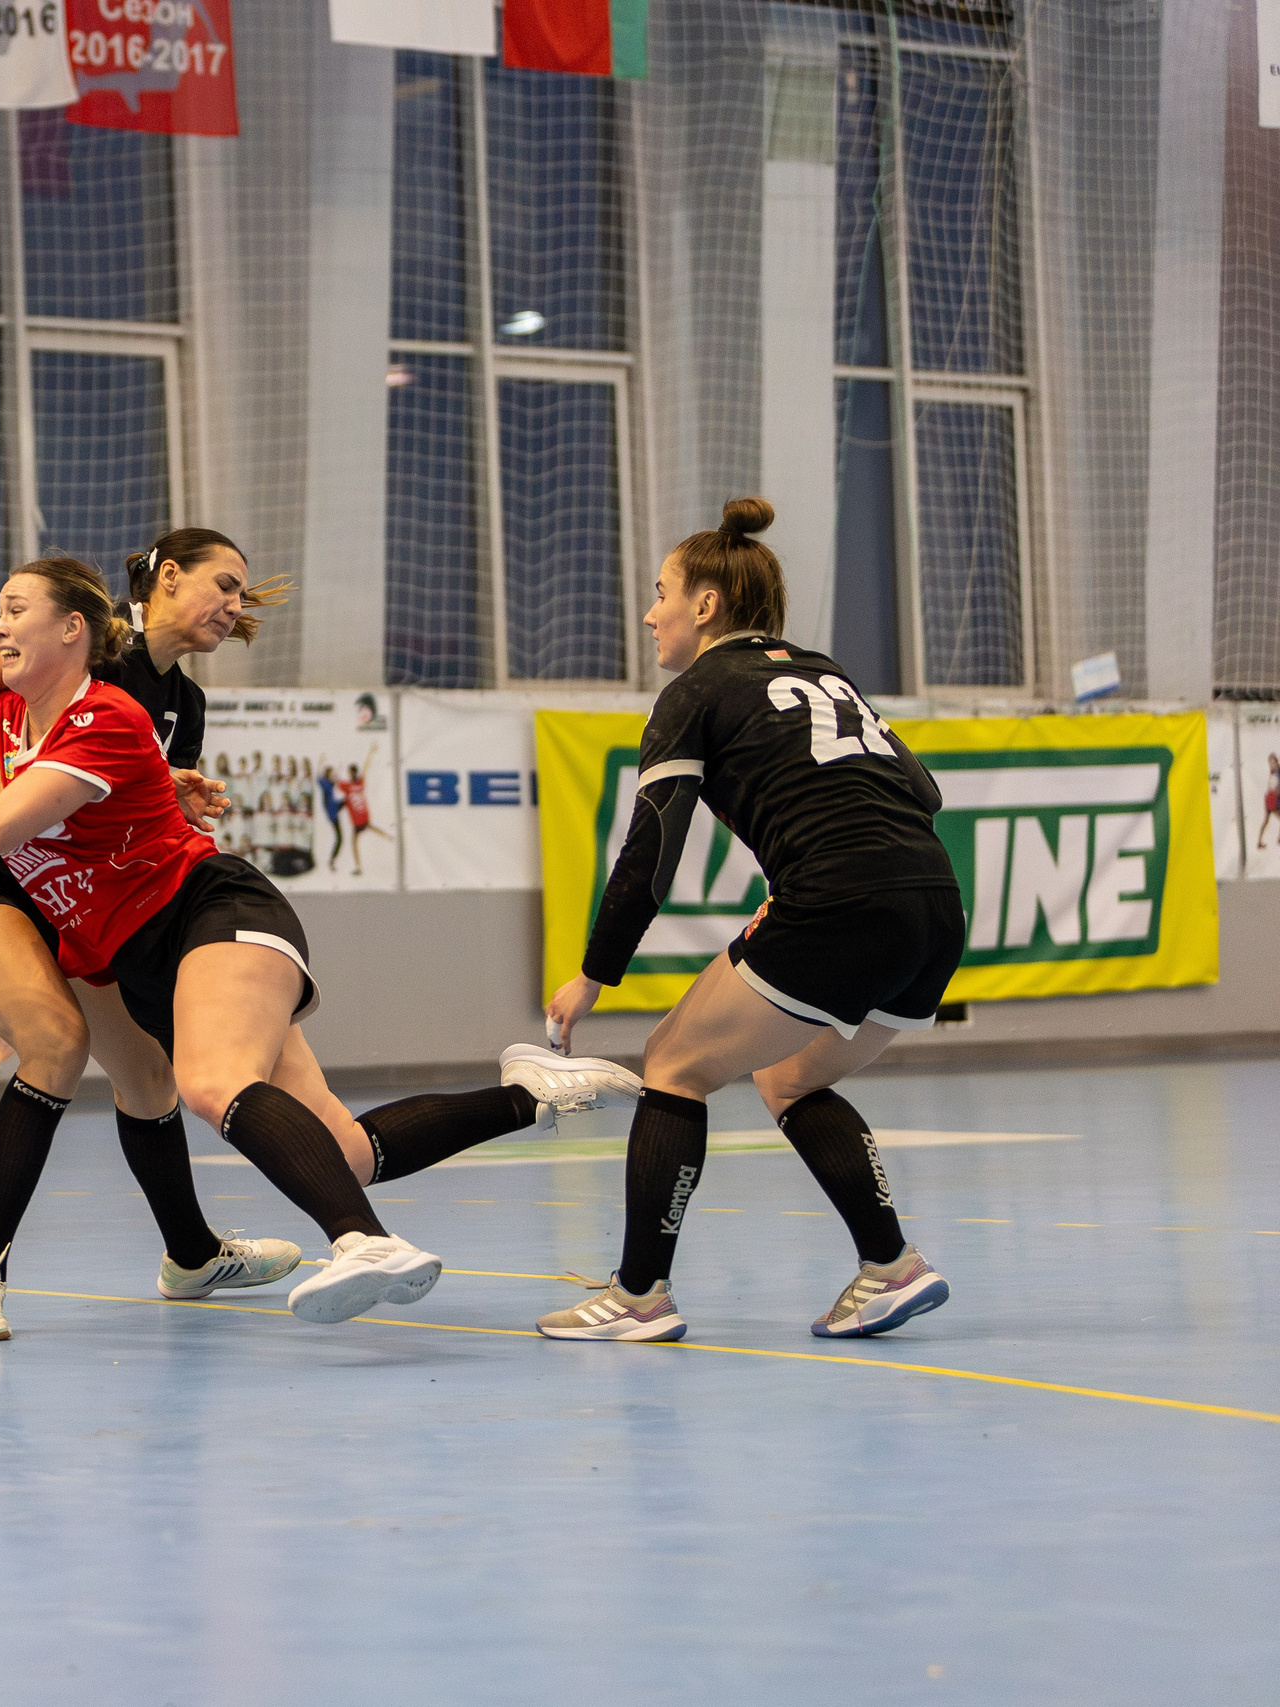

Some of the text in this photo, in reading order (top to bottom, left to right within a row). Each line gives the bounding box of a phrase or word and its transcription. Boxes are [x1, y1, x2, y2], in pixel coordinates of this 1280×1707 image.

[70, 31, 228, 76] 2016-2017
[163, 711, 178, 753] 7
[767, 674, 898, 765] 22
[406, 770, 538, 806] BE
[660, 1164, 698, 1235] Kempa
[861, 1132, 895, 1209] Kempa
